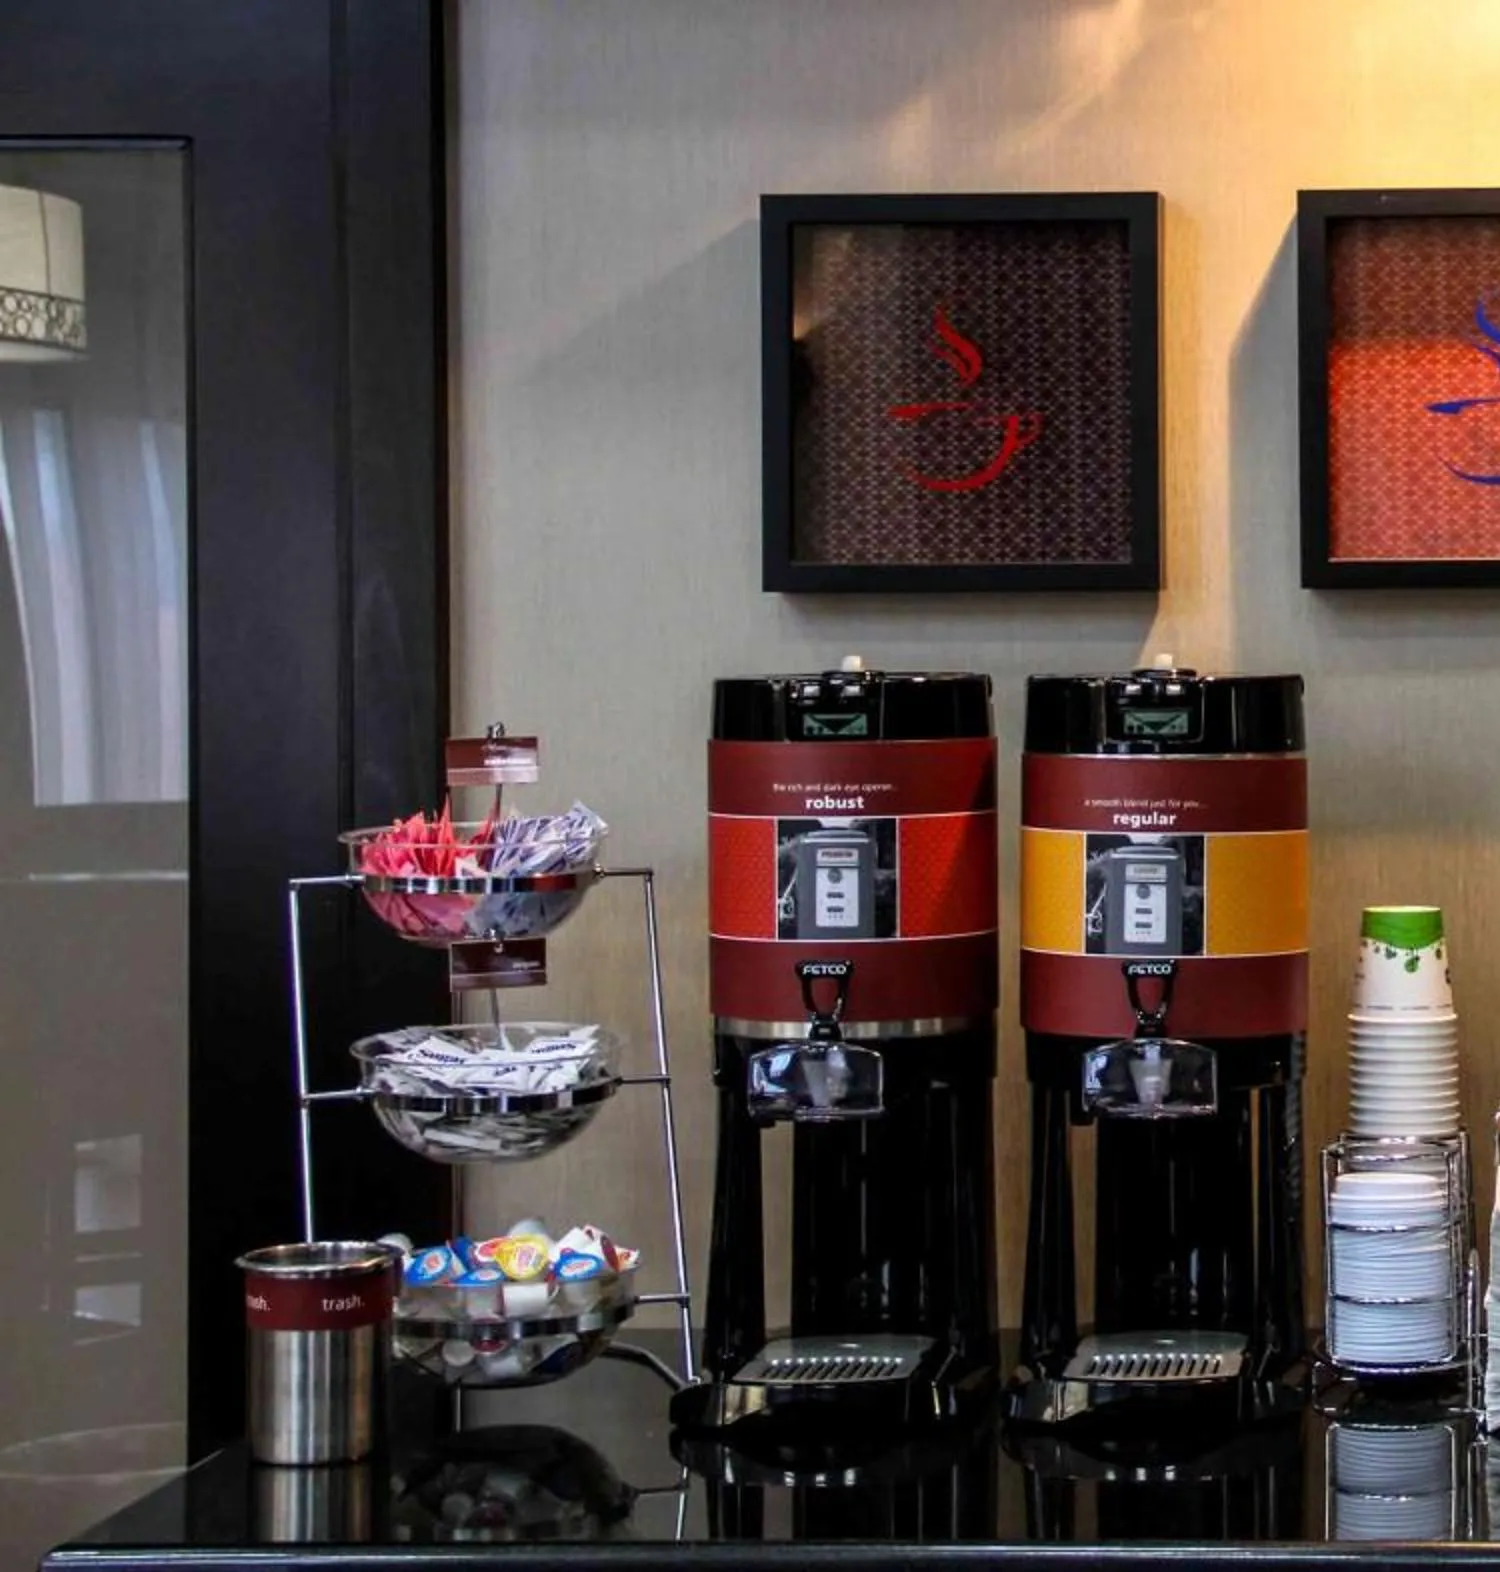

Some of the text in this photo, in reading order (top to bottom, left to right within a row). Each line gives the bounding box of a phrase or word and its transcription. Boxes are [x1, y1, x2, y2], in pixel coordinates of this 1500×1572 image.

[805, 795, 865, 809] robust
[1113, 811, 1178, 829] regular
[802, 963, 847, 975] FETCO
[1128, 963, 1171, 975] FETCO
[322, 1294, 366, 1312] trash.
